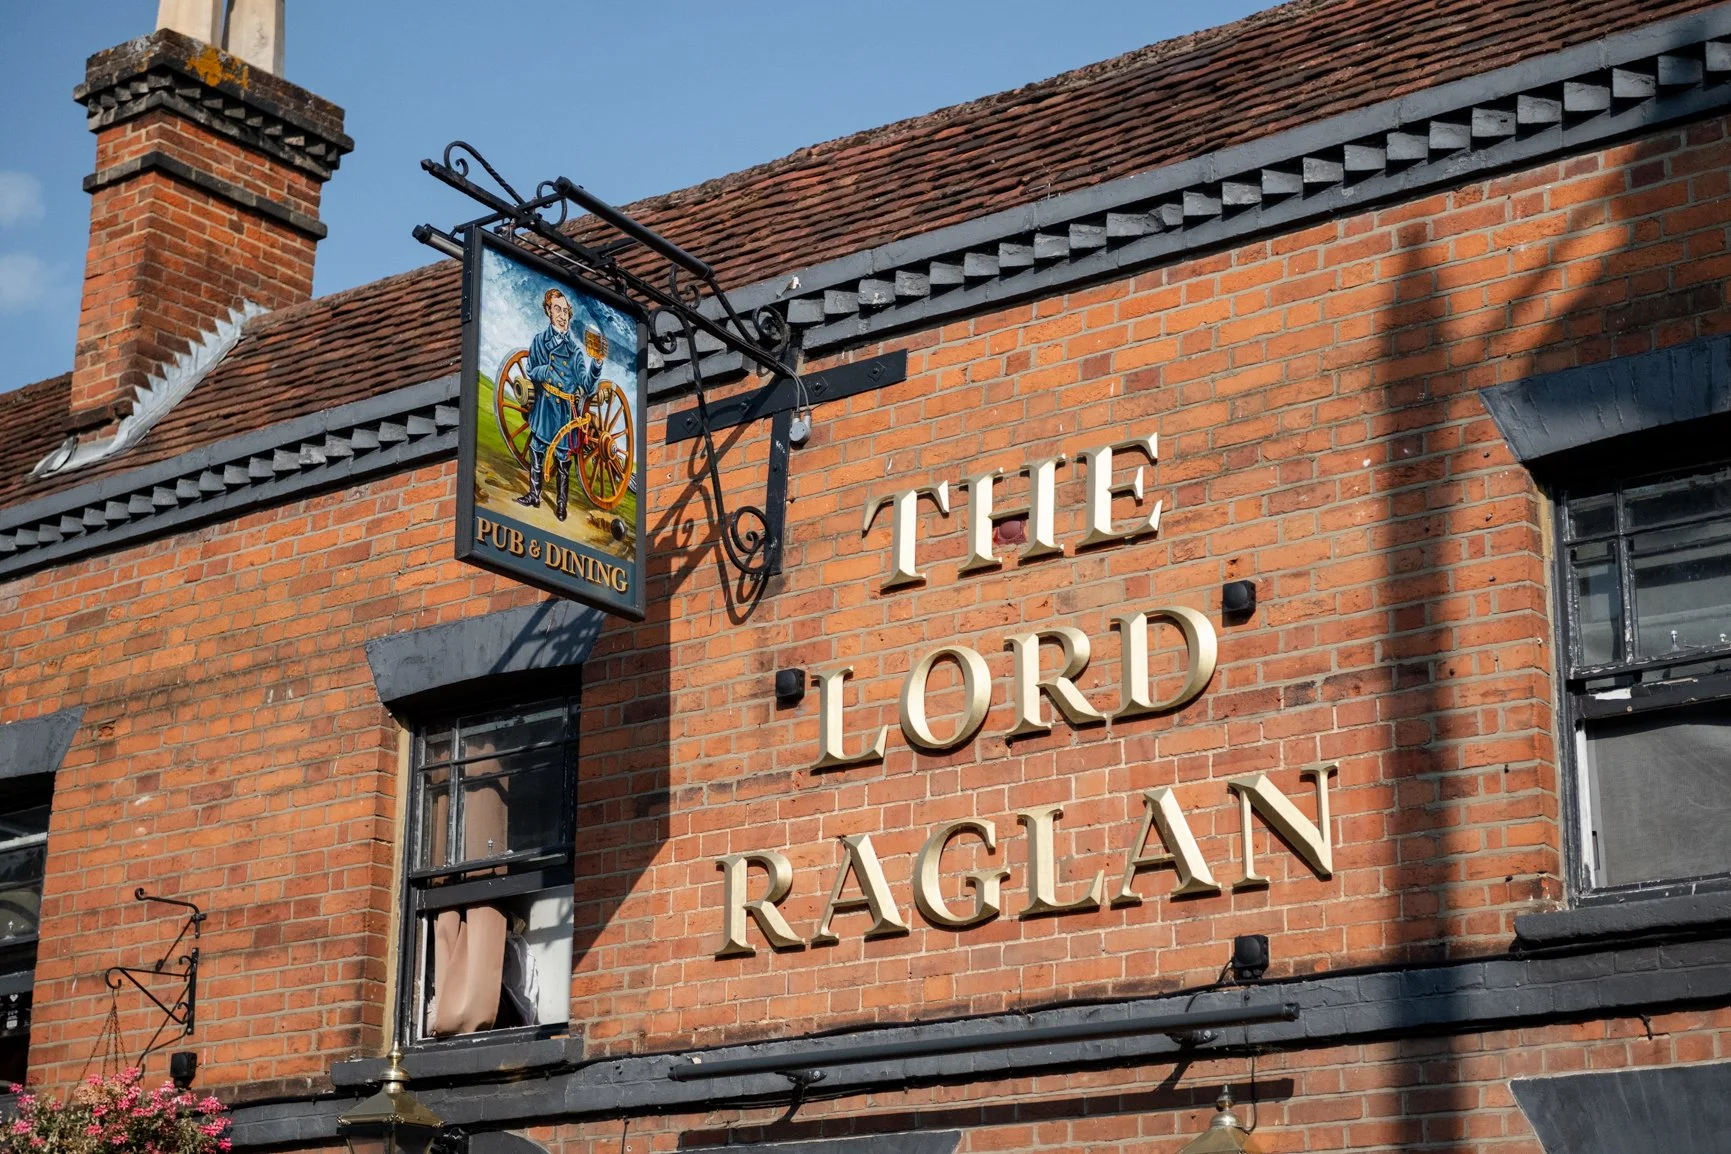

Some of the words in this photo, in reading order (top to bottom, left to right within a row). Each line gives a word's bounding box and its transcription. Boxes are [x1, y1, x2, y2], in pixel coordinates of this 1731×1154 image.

[476, 516, 524, 555] PUB
[528, 539, 541, 558] &
[545, 541, 628, 592] DINING
[862, 432, 1163, 590] THE
[811, 605, 1218, 770] LORD
[715, 761, 1338, 958] RAGLAN
